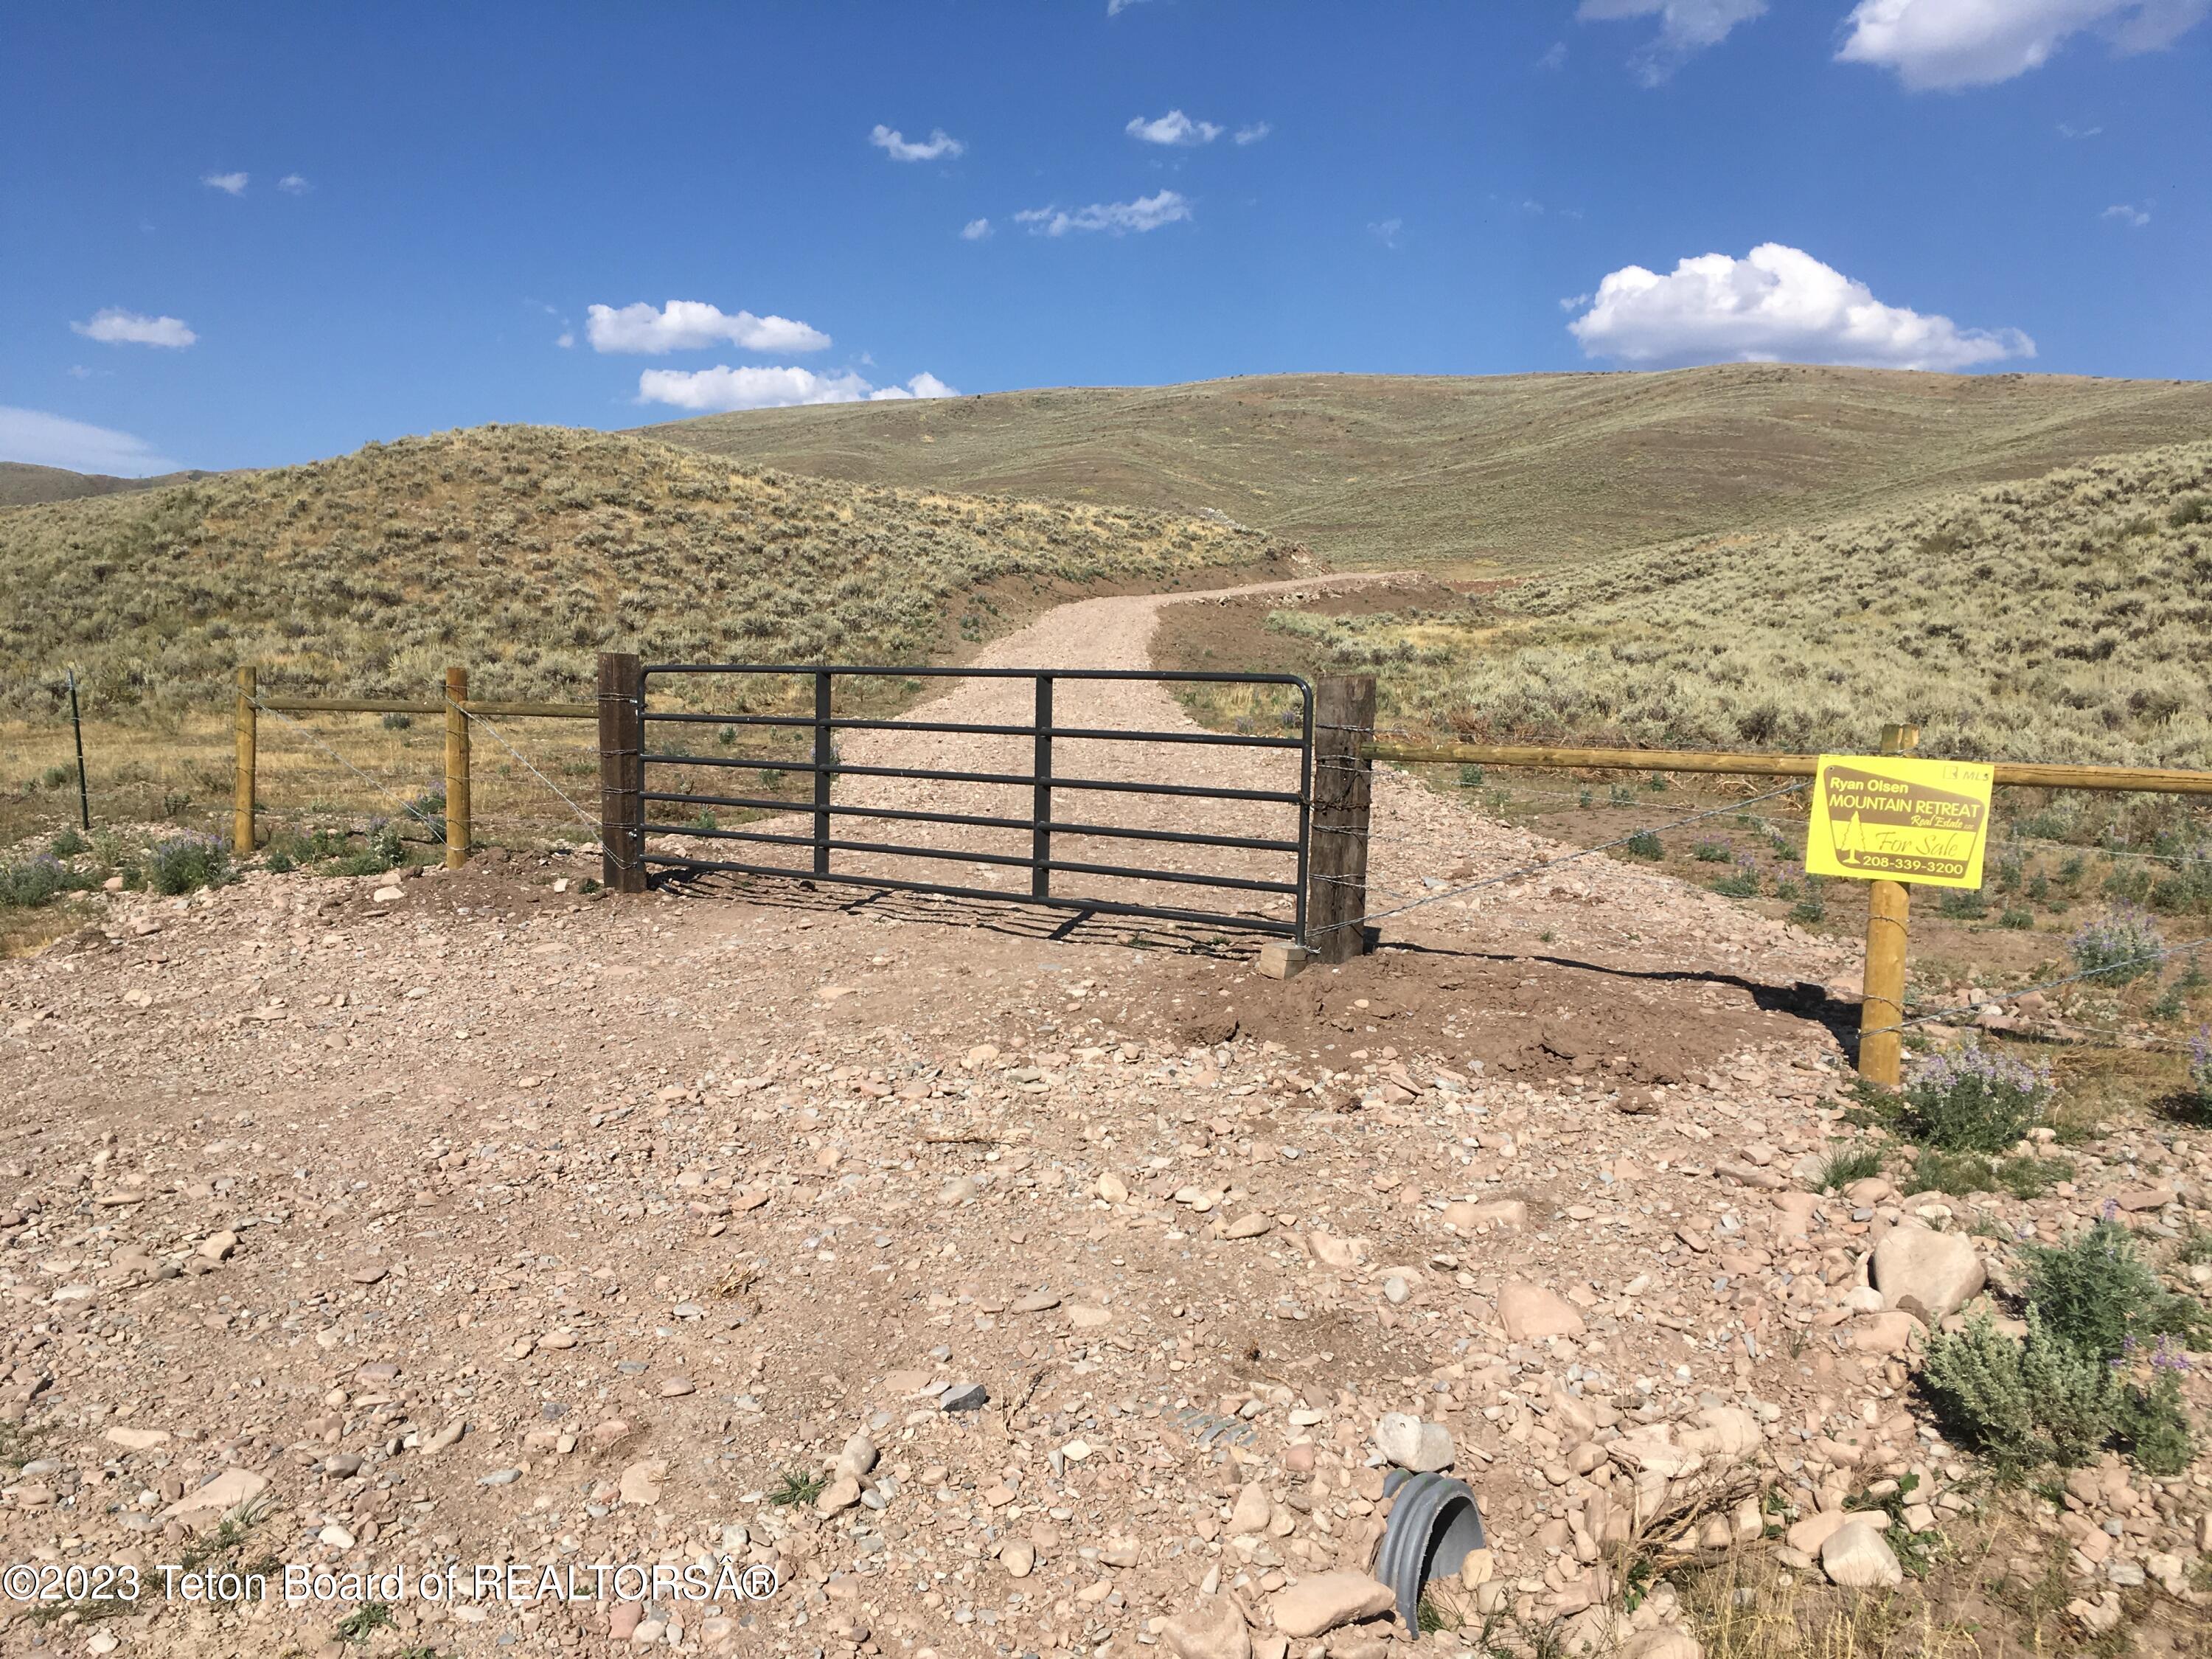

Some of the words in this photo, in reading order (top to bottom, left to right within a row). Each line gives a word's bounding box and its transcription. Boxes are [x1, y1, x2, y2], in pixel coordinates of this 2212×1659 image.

[1829, 776, 1863, 790] Ryan
[1867, 779, 1908, 793] Olsen
[1829, 794, 1911, 813] MOUNTAIN
[1916, 801, 1980, 818] RETREAT
[1910, 814, 1935, 827] Real
[1934, 816, 1963, 829] Estate
[1876, 832, 1912, 853] For
[1916, 832, 1958, 857] Sale
[1863, 855, 1964, 874] 208-339-3200
